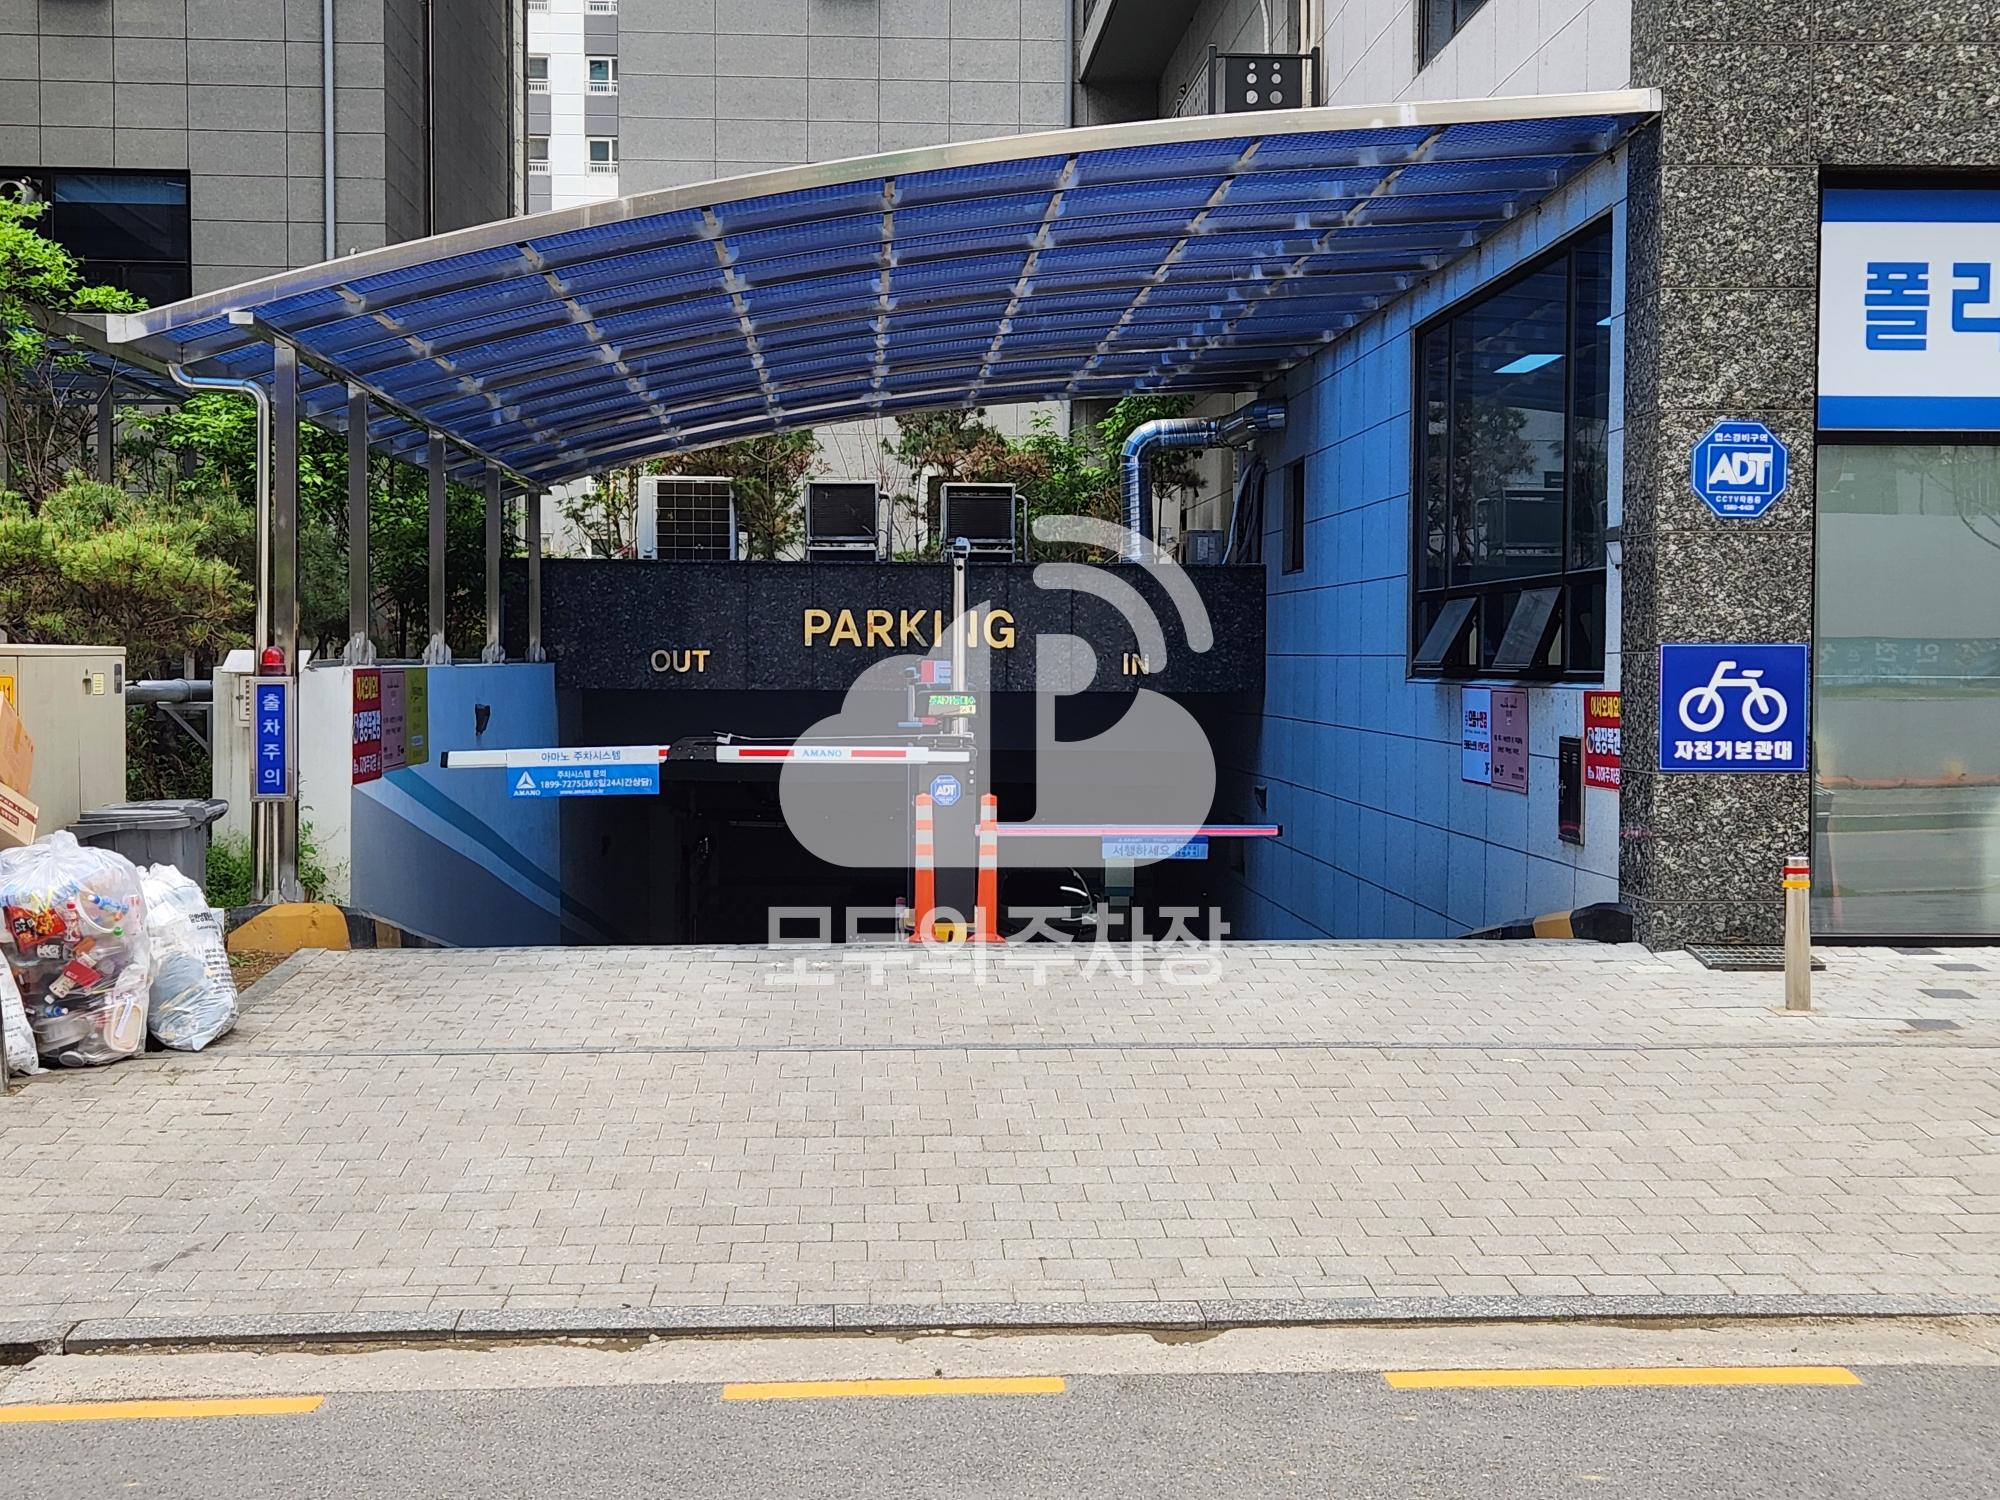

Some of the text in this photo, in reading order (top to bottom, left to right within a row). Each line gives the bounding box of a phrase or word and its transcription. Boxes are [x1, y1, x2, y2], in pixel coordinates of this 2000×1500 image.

[1709, 452, 1772, 485] ADT
[650, 648, 710, 673] OUT
[1121, 652, 1150, 675] IN
[262, 693, 281, 786] 출차주의
[541, 750, 621, 761] 아마노 주차시스템
[802, 749, 842, 757] AMANO
[1674, 741, 1792, 761] 자전거보관대
[935, 784, 957, 796] ADT
[1113, 845, 1170, 856] 서행하세요
